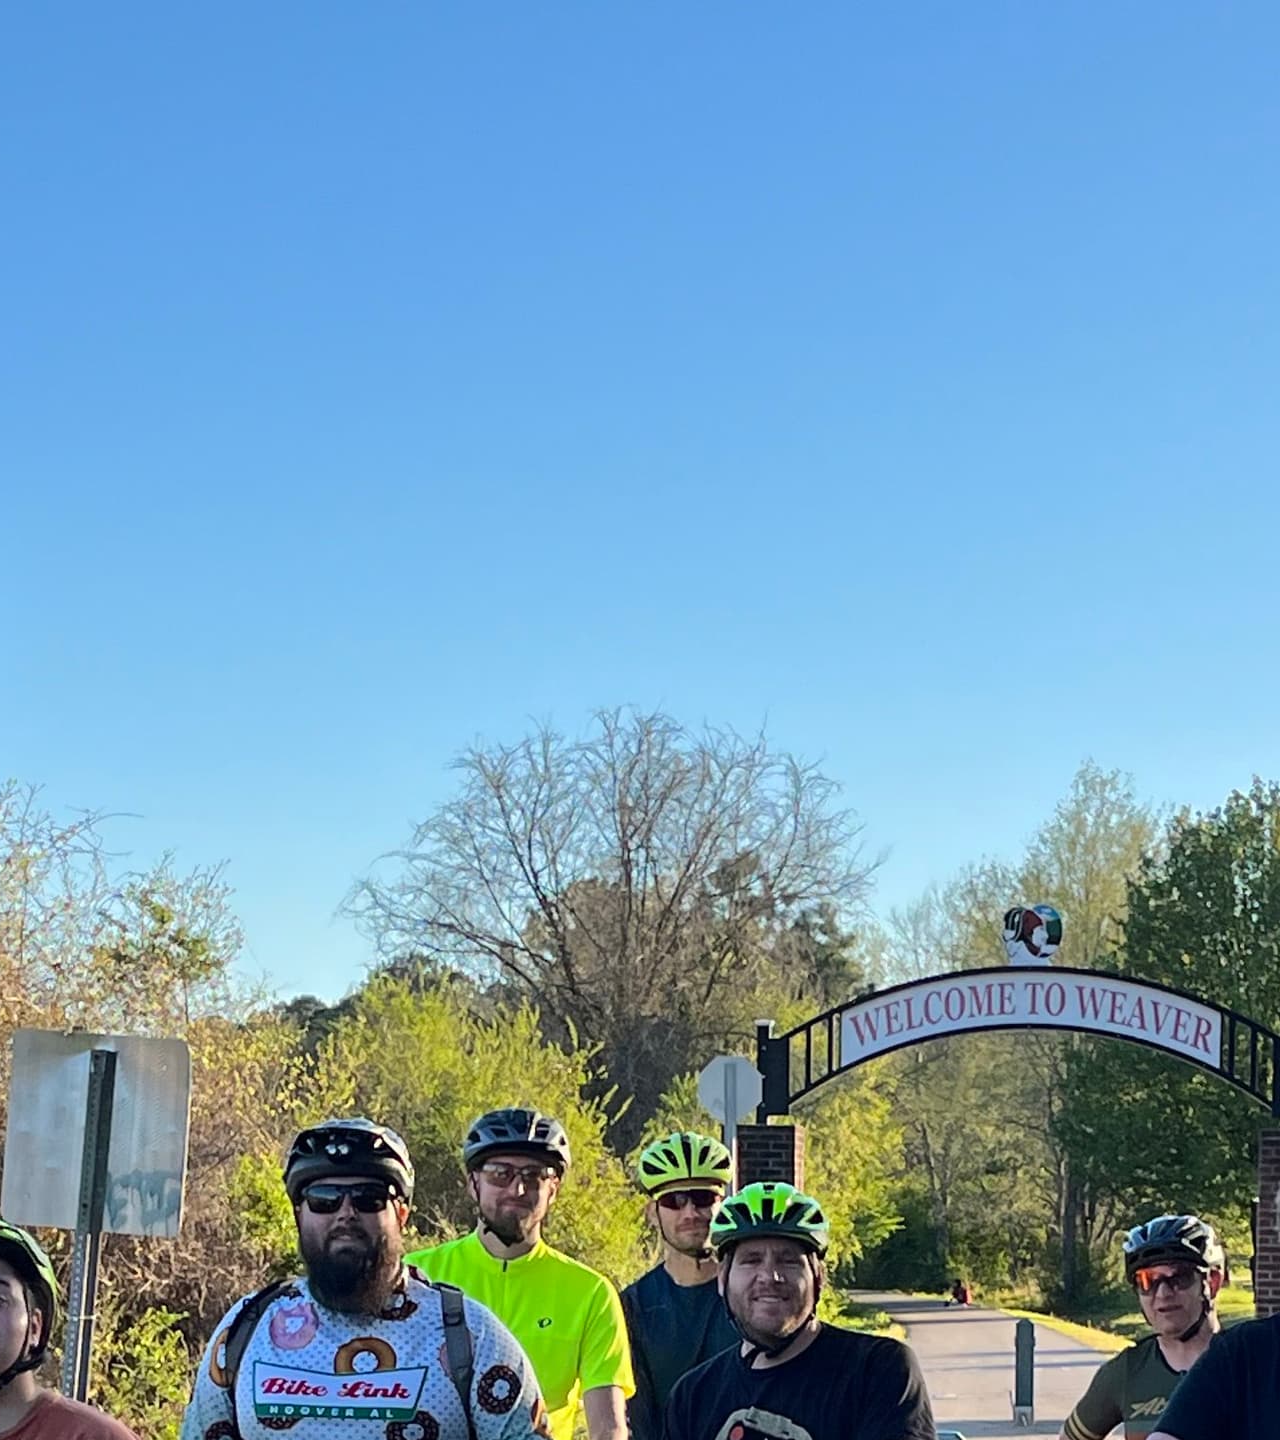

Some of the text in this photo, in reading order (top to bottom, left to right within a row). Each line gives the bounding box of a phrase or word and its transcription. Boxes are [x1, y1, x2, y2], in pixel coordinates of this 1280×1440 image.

[849, 981, 1213, 1055] WELCOME TO WEAVER
[261, 1377, 411, 1399] Bike Link
[269, 1405, 394, 1418] HOOVER AL
